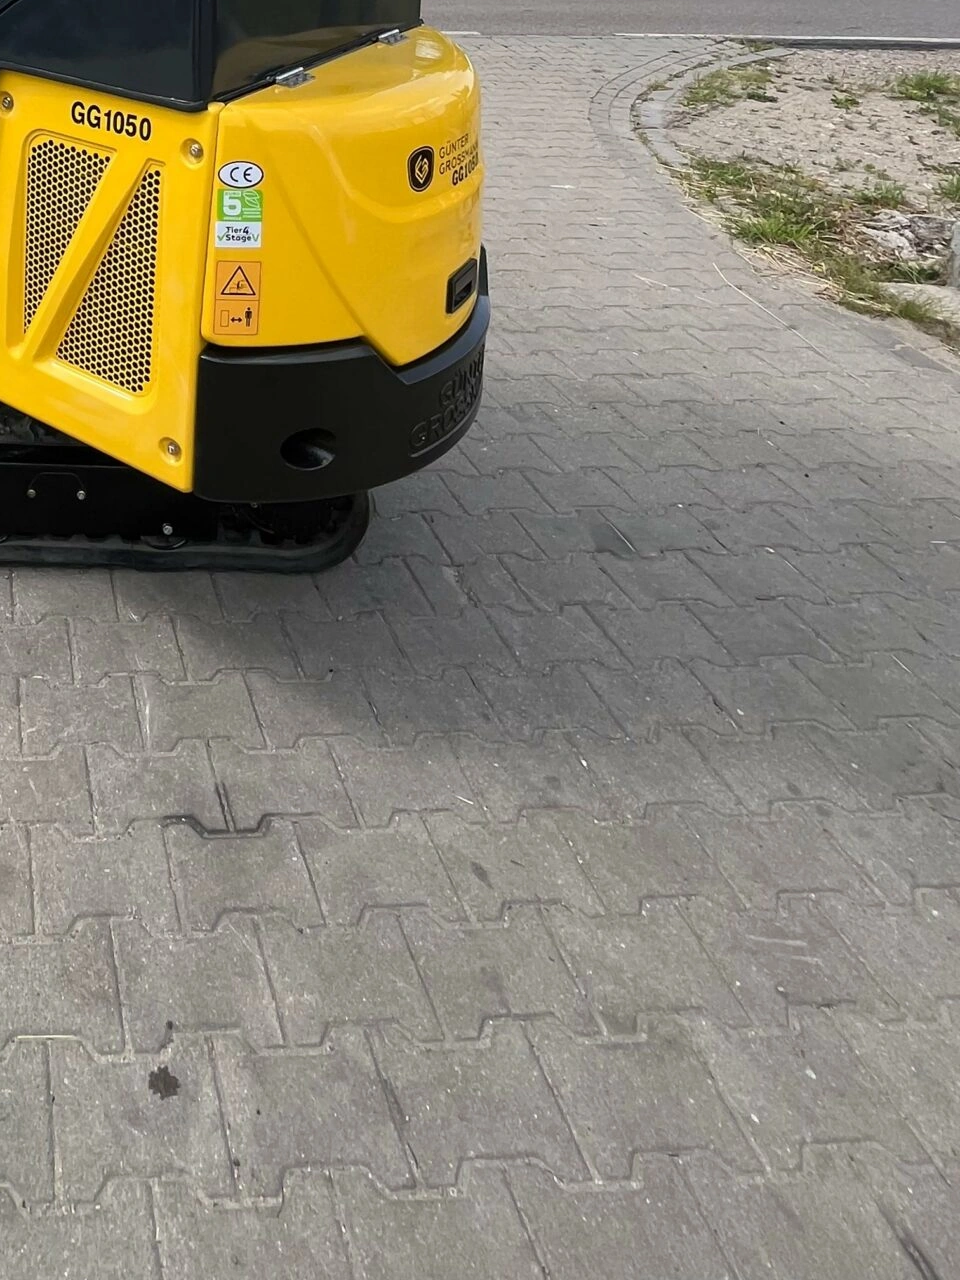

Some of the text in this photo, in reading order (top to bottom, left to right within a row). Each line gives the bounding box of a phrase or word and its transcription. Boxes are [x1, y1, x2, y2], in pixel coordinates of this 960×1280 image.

[71, 101, 152, 141] GG1050
[439, 133, 469, 159] GÜNTER
[223, 190, 241, 217] 5
